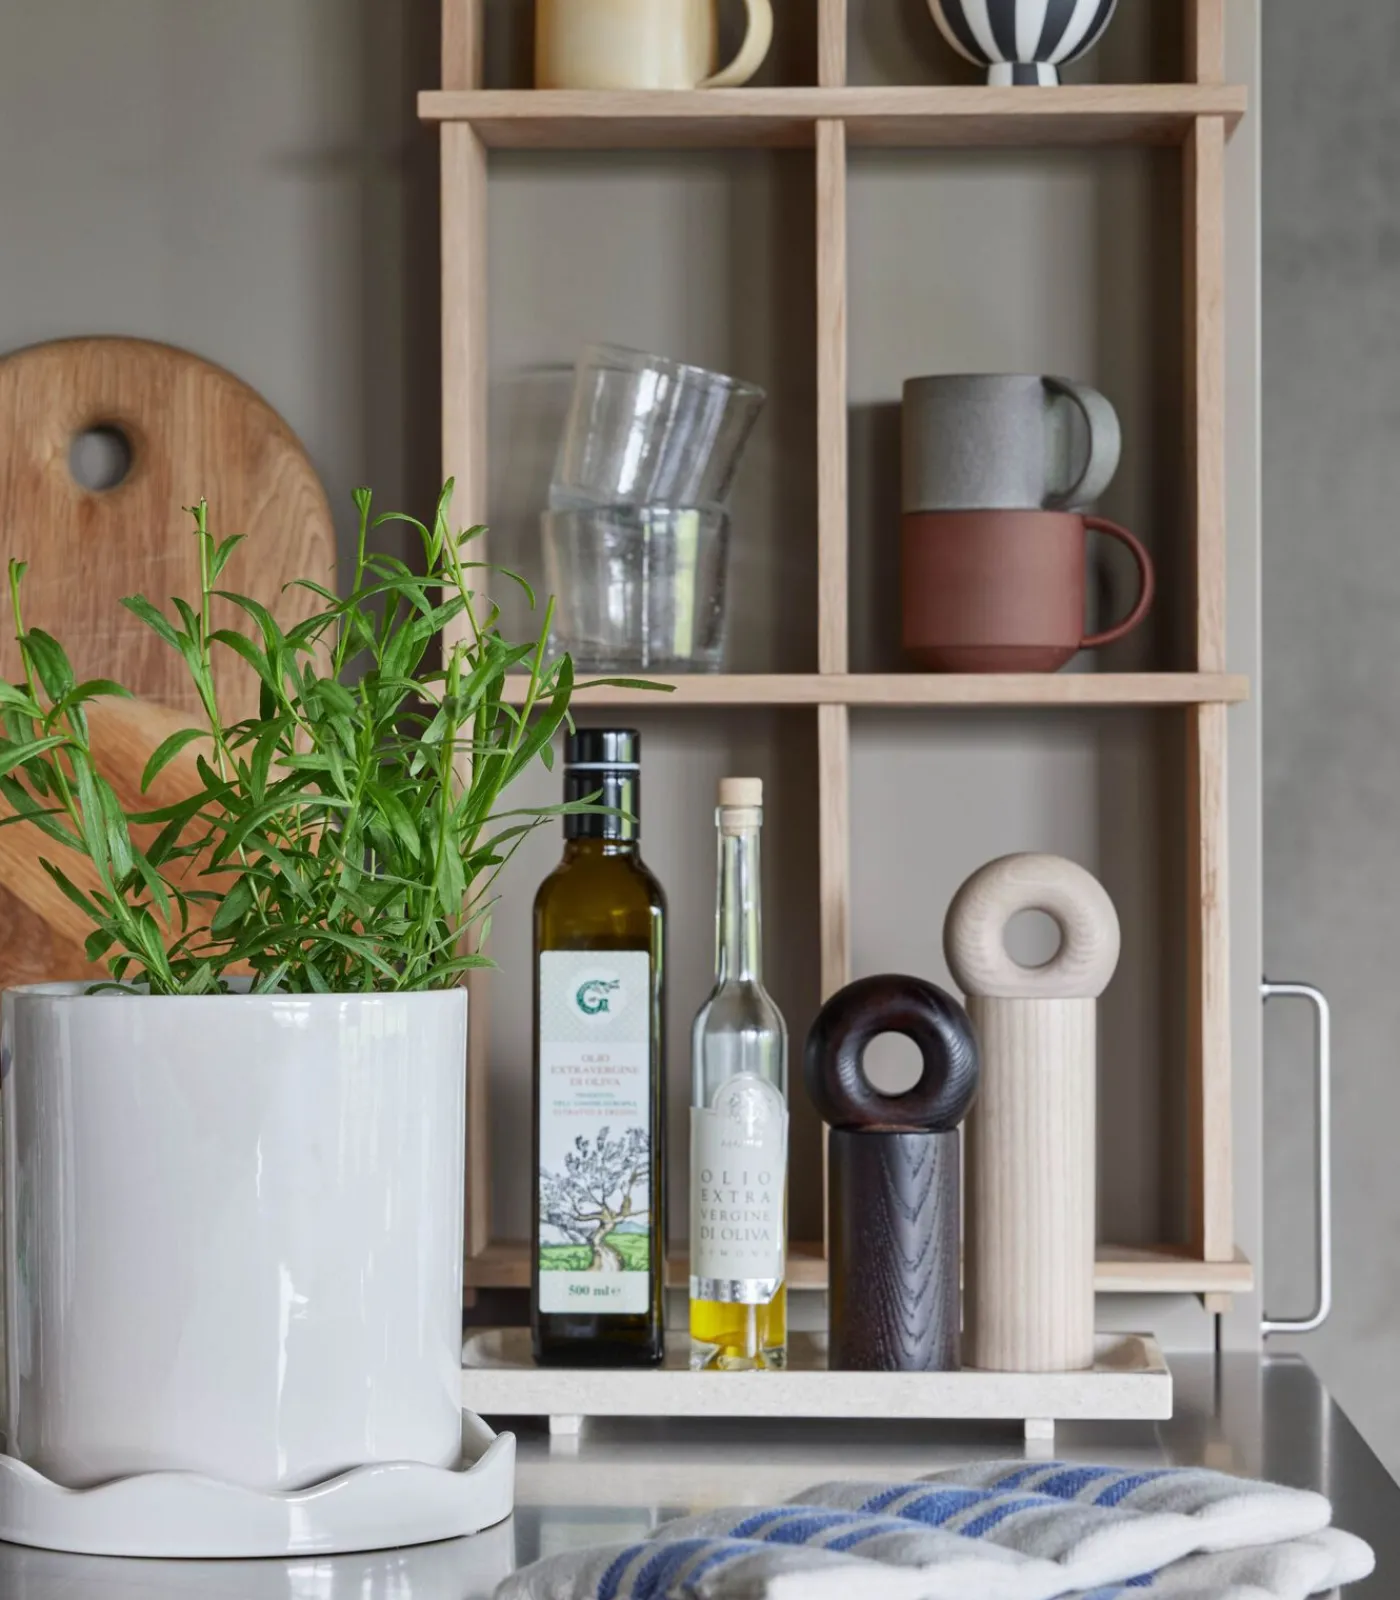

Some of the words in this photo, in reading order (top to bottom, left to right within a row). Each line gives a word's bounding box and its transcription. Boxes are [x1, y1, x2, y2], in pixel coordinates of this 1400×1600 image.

[581, 1053, 610, 1063] OLIO
[551, 1065, 640, 1075] EXTRAVERGINE
[570, 1077, 582, 1087] DI
[585, 1077, 621, 1087] OLIVA
[700, 1169, 772, 1186] OLIO
[701, 1188, 771, 1204] EXTRA
[700, 1209, 771, 1222] VERGINE
[700, 1226, 715, 1241] DI
[720, 1227, 771, 1242] OLIVA
[568, 1283, 591, 1297] 500
[593, 1284, 610, 1297] ml
